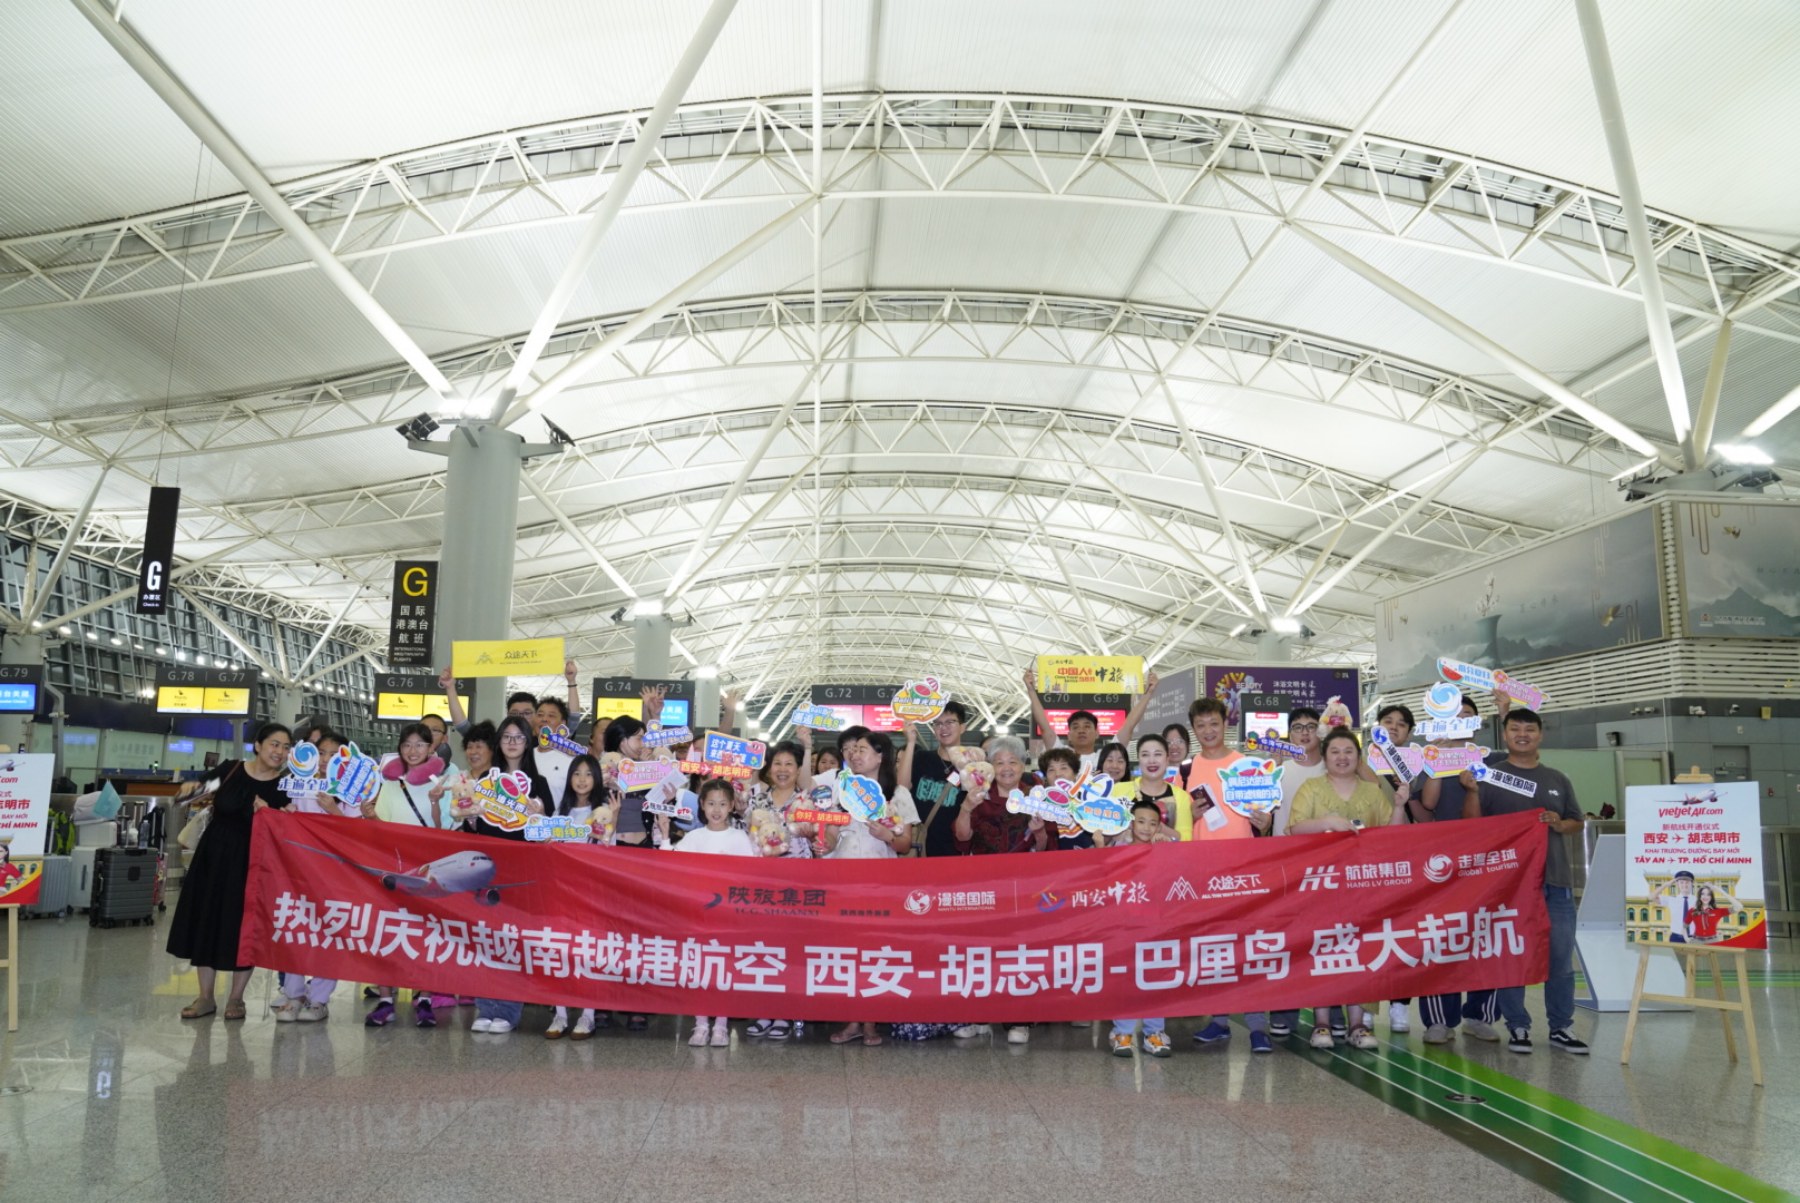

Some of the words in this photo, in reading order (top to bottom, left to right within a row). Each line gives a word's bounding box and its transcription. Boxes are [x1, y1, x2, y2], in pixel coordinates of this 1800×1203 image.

[147, 561, 162, 591] G
[403, 567, 428, 597] G
[401, 605, 426, 616] 国际
[396, 619, 429, 630] 港澳台
[399, 633, 424, 644] 航班
[168, 671, 195, 681] G.78
[218, 673, 245, 682] G.77
[387, 677, 414, 688] G.76
[605, 681, 632, 692] G.74
[656, 683, 683, 694] G73
[825, 687, 852, 698] G.72
[877, 688, 897, 698] G.7
[1043, 693, 1070, 703] G.70
[1093, 693, 1119, 703] G.69
[1253, 696, 1280, 706] G.68
[1644, 833, 1669, 844] 西安
[1687, 832, 1740, 844] 胡志明市
[1458, 848, 1517, 869] 走遍全球
[1726, 856, 1752, 864] MINH
[1345, 861, 1411, 880] 航旅集团
[1458, 868, 1483, 877] Global
[1487, 861, 1519, 873] tourism
[1208, 874, 1262, 891] 众途天下
[1384, 878, 1412, 886] GROUP
[728, 886, 827, 907] 陕旅集团
[938, 891, 996, 907] 漫途国际
[271, 891, 787, 993] 热烈庆祝越南越捷航空
[804, 929, 1291, 999] 西安-胡志明-巴厘岛
[1309, 903, 1526, 977] 盛大起航
